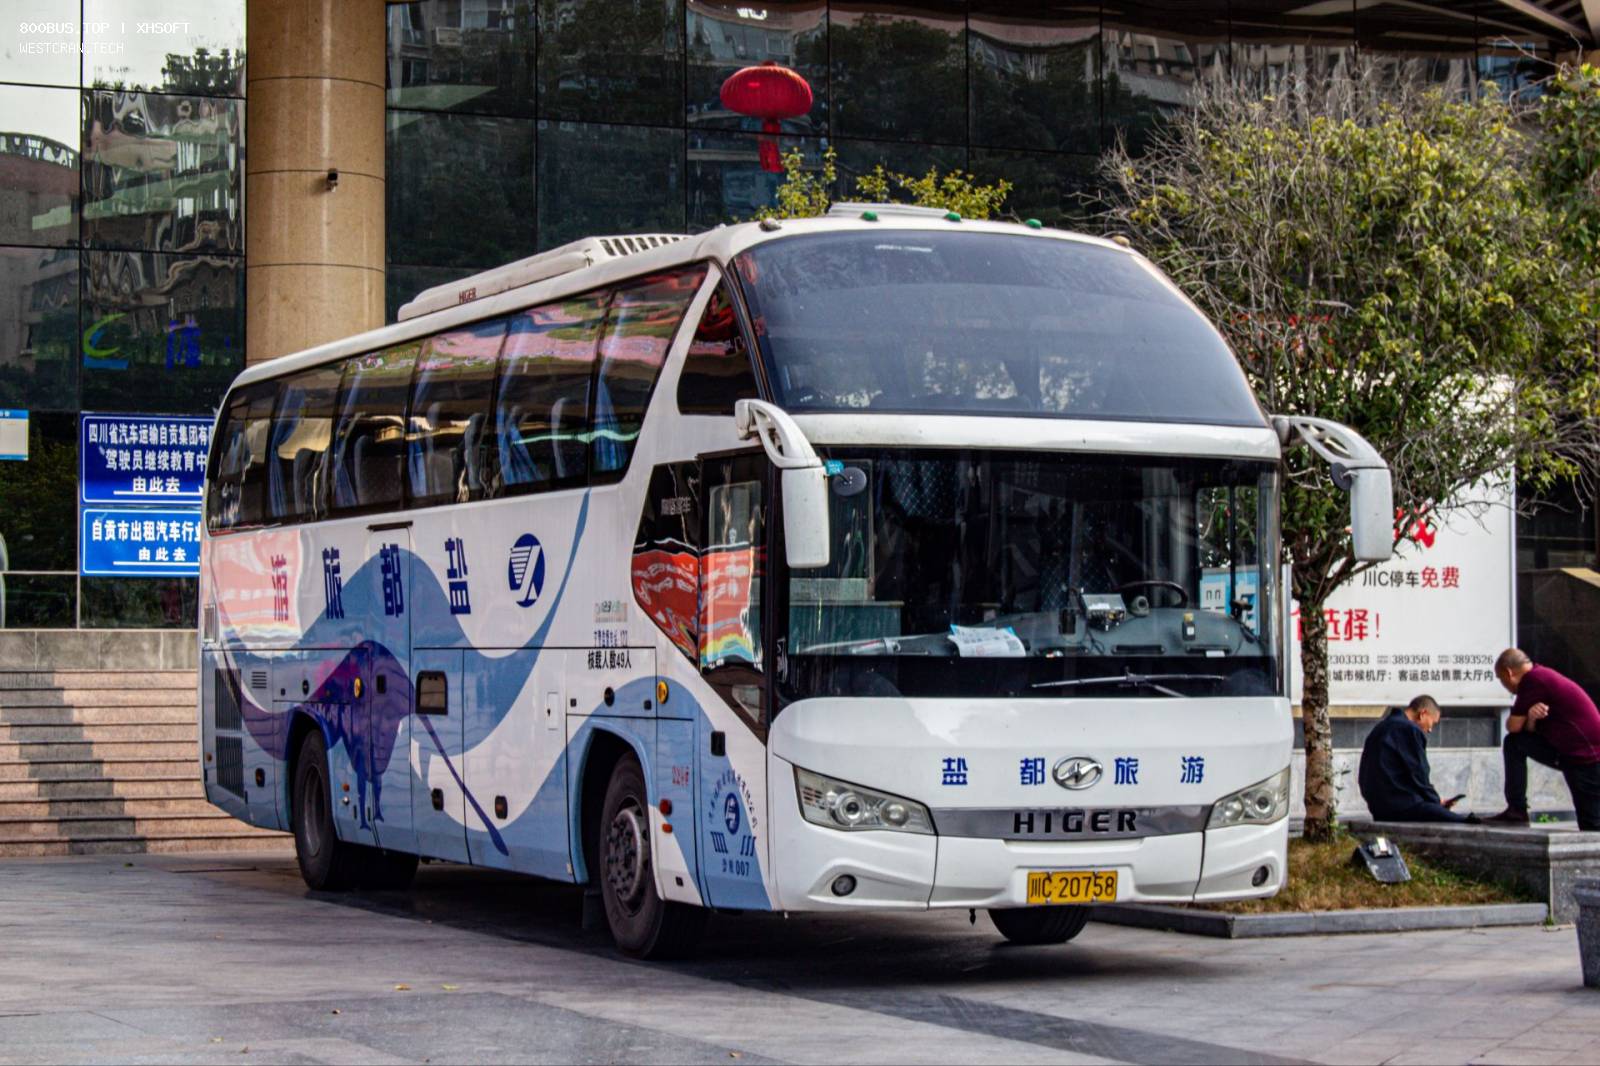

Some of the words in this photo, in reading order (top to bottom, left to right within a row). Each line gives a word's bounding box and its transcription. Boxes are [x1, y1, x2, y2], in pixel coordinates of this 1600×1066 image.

[105, 449, 207, 472] 驾驶员继续教育中
[132, 476, 181, 492] 由此去
[138, 546, 187, 561] 由此去
[1013, 811, 1137, 834] HIGER
